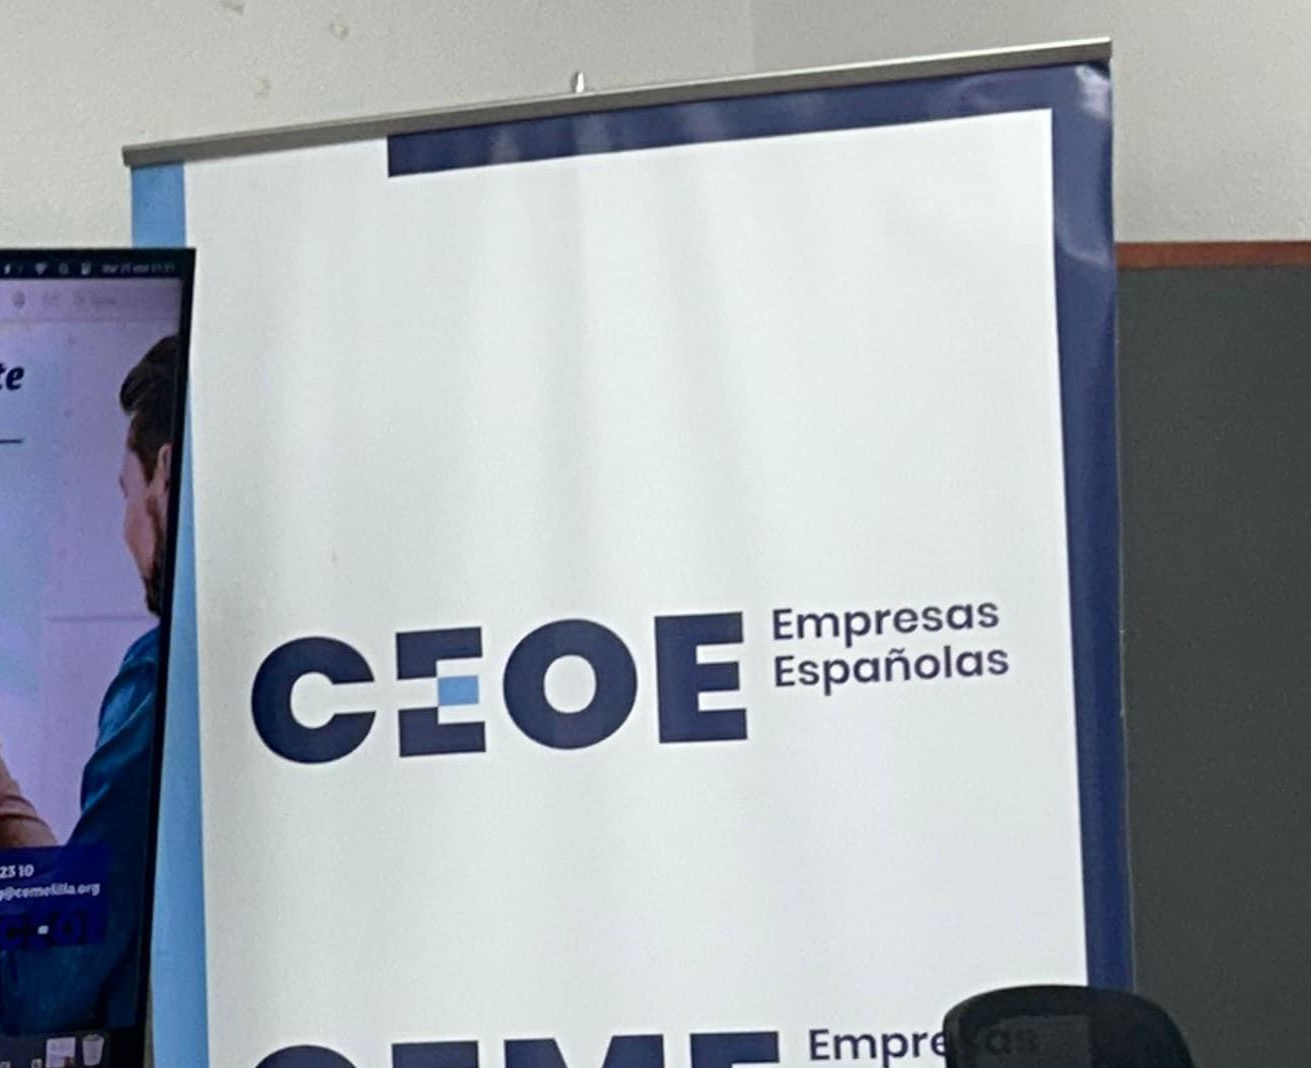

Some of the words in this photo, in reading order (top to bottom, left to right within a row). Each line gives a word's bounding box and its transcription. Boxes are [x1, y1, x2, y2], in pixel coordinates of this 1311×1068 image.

[773, 602, 1000, 648] Empresas
[251, 611, 748, 765] CEOE
[775, 645, 1010, 696] Españolas
